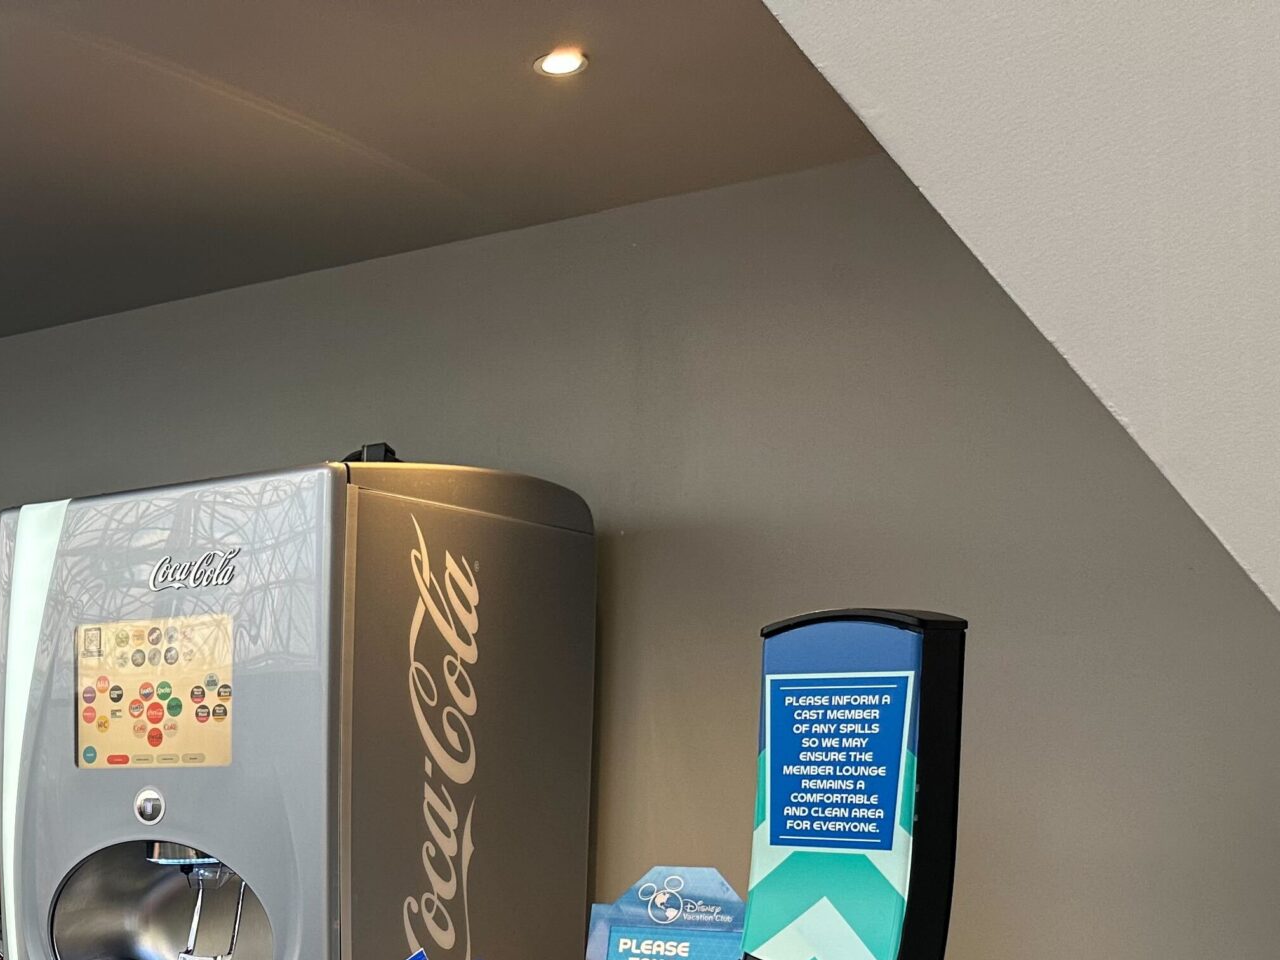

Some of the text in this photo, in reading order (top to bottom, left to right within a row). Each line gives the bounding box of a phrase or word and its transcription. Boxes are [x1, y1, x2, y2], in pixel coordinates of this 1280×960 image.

[149, 546, 241, 592] Coca-Cola
[784, 694, 891, 706] PLEASE INFORM A
[793, 709, 880, 720] CAST MEMBER
[792, 723, 880, 734] OF ANY SPILLS
[801, 737, 869, 748] SO WE MAY
[799, 751, 873, 762] ENSURE THE
[782, 765, 887, 777] MEMBER LOUNGE
[801, 779, 865, 790] REMAINS A
[790, 792, 879, 805] COMFORTABLE
[783, 806, 884, 819] AND CLEAN AREA
[786, 819, 880, 833] FOR EVERYONE.
[682, 898, 721, 917] Disney
[682, 912, 733, 923] Vacation Club
[618, 938, 690, 958] PLEASE
